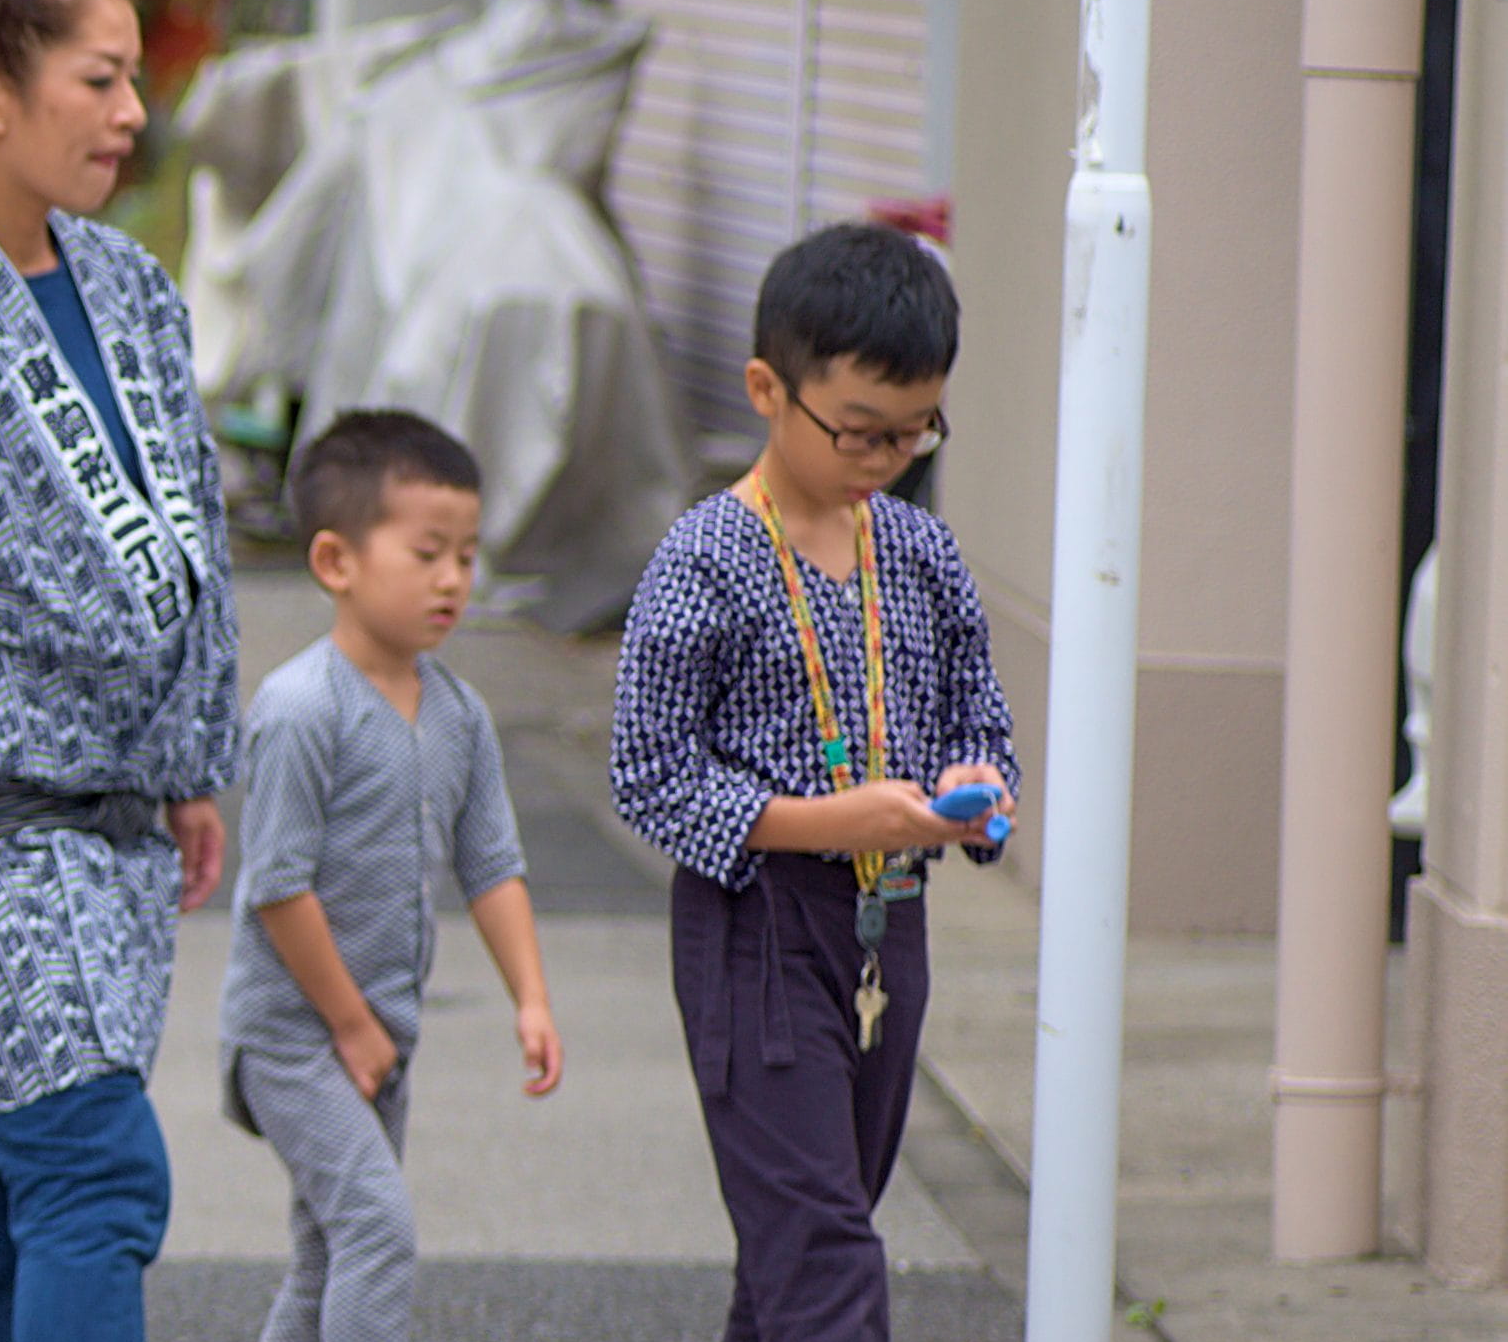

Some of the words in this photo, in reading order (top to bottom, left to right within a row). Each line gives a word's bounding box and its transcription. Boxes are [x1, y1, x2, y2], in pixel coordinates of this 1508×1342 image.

[19, 353, 181, 633] 東駒形二丁目
